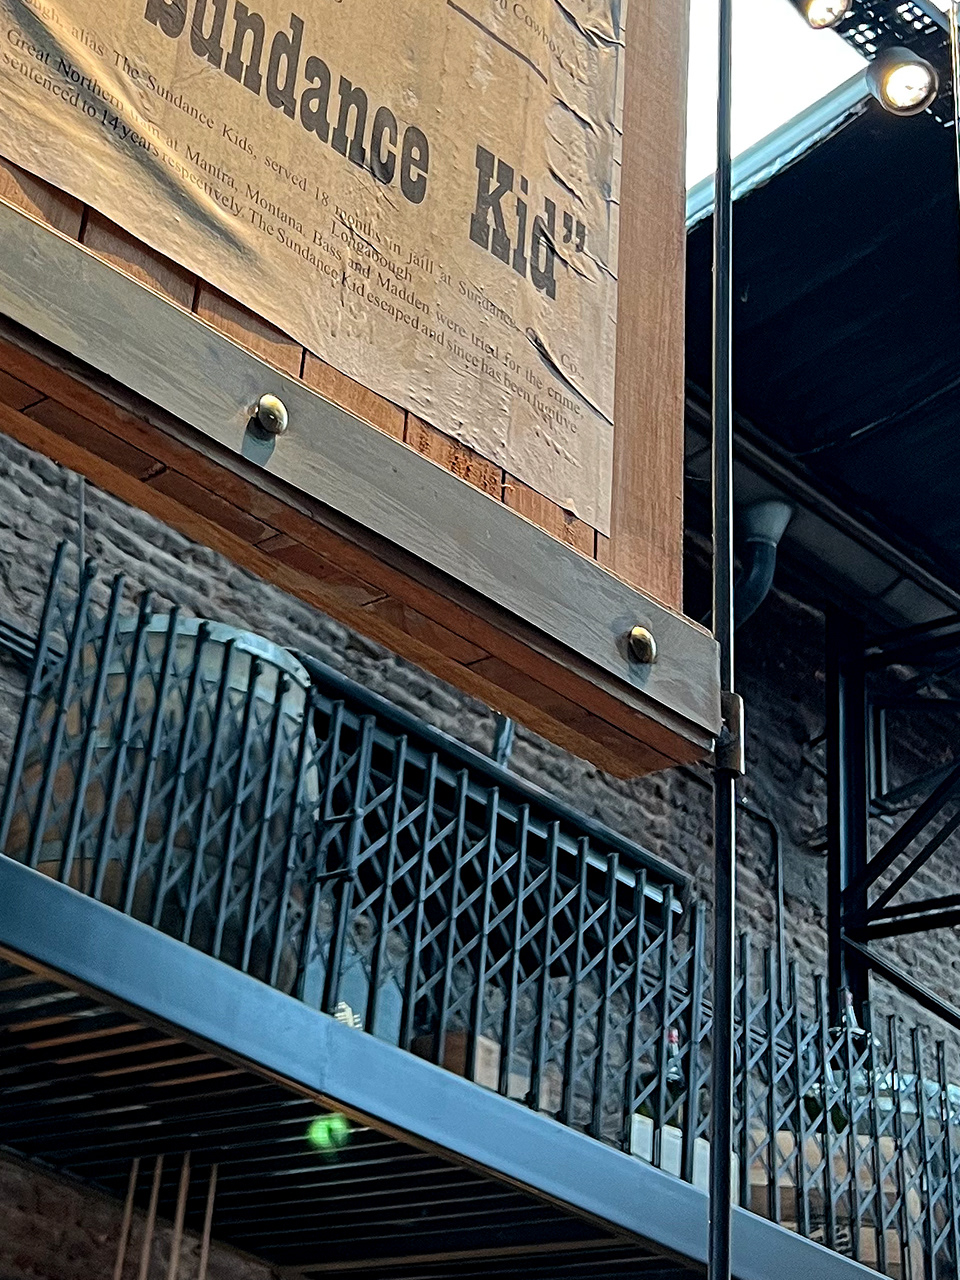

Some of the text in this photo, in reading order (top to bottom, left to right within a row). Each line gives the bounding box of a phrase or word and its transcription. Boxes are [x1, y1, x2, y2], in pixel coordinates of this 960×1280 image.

[70, 27, 105, 56] alias
[113, 49, 139, 80] The
[146, 74, 214, 130] Sundance
[221, 122, 257, 160] Kids,
[263, 156, 307, 192] served
[315, 187, 329, 207] 18
[333, 203, 381, 243] months
[388, 235, 401, 256] in
[440, 270, 451, 286] at
[512, 1, 564, 62] Cowboy
[3, 52, 80, 107] sentenced
[82, 100, 96, 118] to
[101, 108, 119, 130] 14
[119, 124, 160, 157] years
[249, 206, 274, 236] The
[276, 226, 338, 279] Sundance
[340, 269, 366, 298] Kid
[366, 291, 419, 330] escaped
[421, 324, 444, 346] and
[446, 338, 478, 368] since
[480, 357, 502, 383] has
[503, 372, 530, 403] been
[6, 27, 49, 66] Great
[56, 57, 125, 112] Northern
[165, 136, 178, 151] at
[184, 143, 237, 192] Mantra,
[312, 228, 342, 260] Bass
[347, 256, 372, 280] and
[376, 269, 430, 315] Madden
[435, 310, 466, 338] were
[471, 332, 500, 361] tried
[505, 353, 521, 375] for
[525, 369, 542, 390] the
